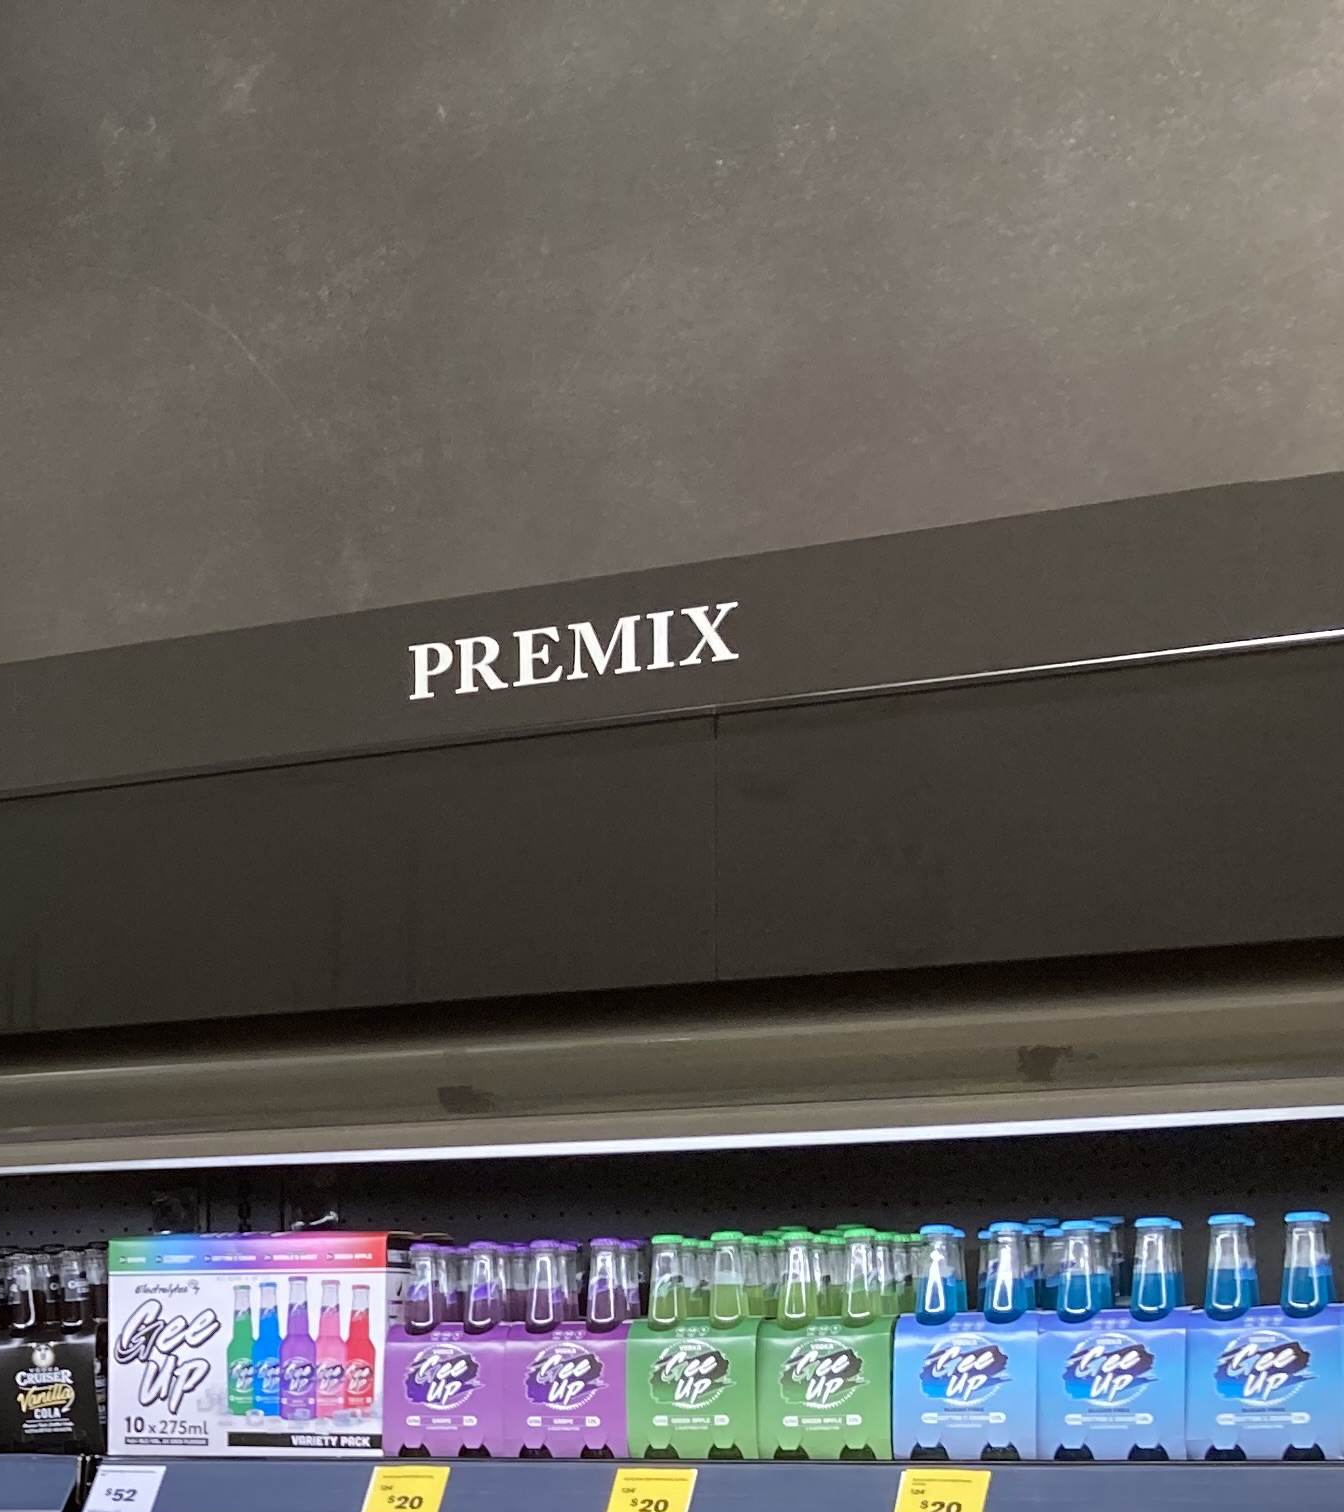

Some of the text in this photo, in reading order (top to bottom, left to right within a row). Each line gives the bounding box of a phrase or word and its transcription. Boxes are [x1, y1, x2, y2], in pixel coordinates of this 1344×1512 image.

[408, 601, 739, 700] PREMIX
[114, 1300, 221, 1364] Gee
[417, 1352, 468, 1382] Gee
[1233, 1345, 1297, 1376] Gee
[17, 1384, 75, 1412] Vanilla
[33, 1408, 62, 1420] COLA
[124, 1417, 143, 1433] 10
[160, 1417, 208, 1434] 275ml
[291, 1435, 371, 1448] VARIETY PACK
[105, 1488, 137, 1502] $52
[387, 1494, 423, 1510] $20
